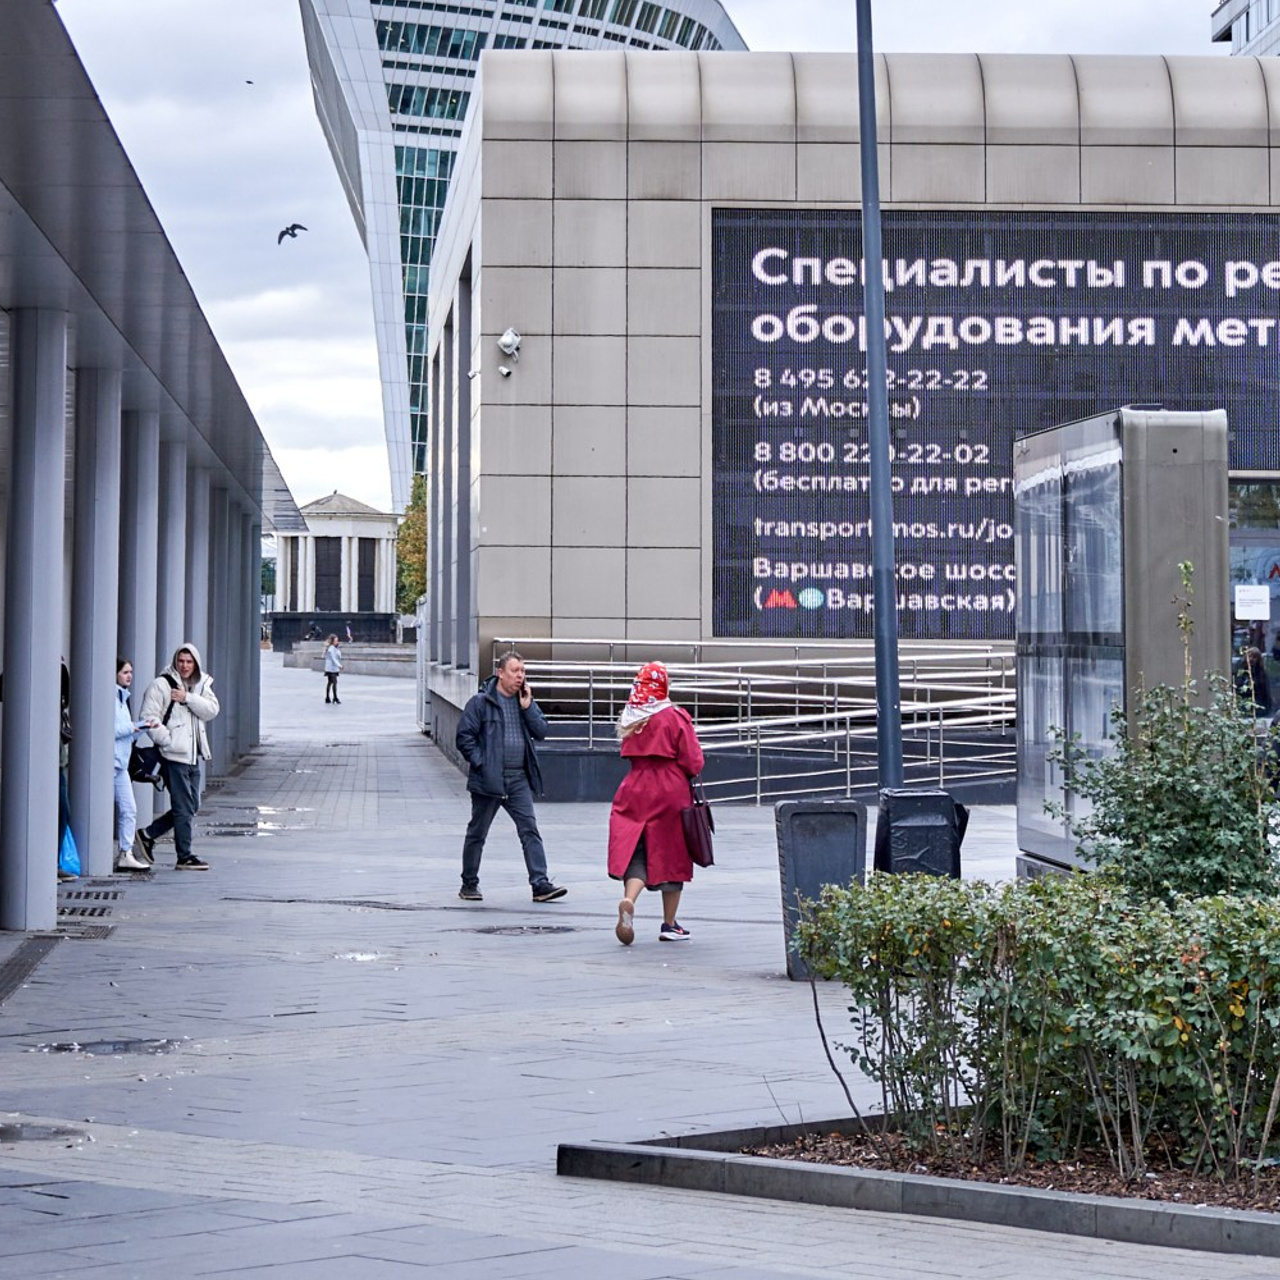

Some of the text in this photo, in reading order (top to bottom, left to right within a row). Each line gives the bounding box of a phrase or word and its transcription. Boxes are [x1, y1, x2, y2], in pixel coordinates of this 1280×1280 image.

[751, 246, 1125, 293] Специалисты
[1142, 259, 1209, 289] по
[750, 304, 1276, 353] оборудования мет
[754, 368, 772, 389] 8
[779, 368, 835, 389] 495
[753, 394, 921, 419] (из Мосы)
[754, 442, 772, 462] 8
[779, 442, 835, 463] 800
[753, 469, 1015, 496] (бесплато для рег
[752, 557, 935, 582] Варшавое
